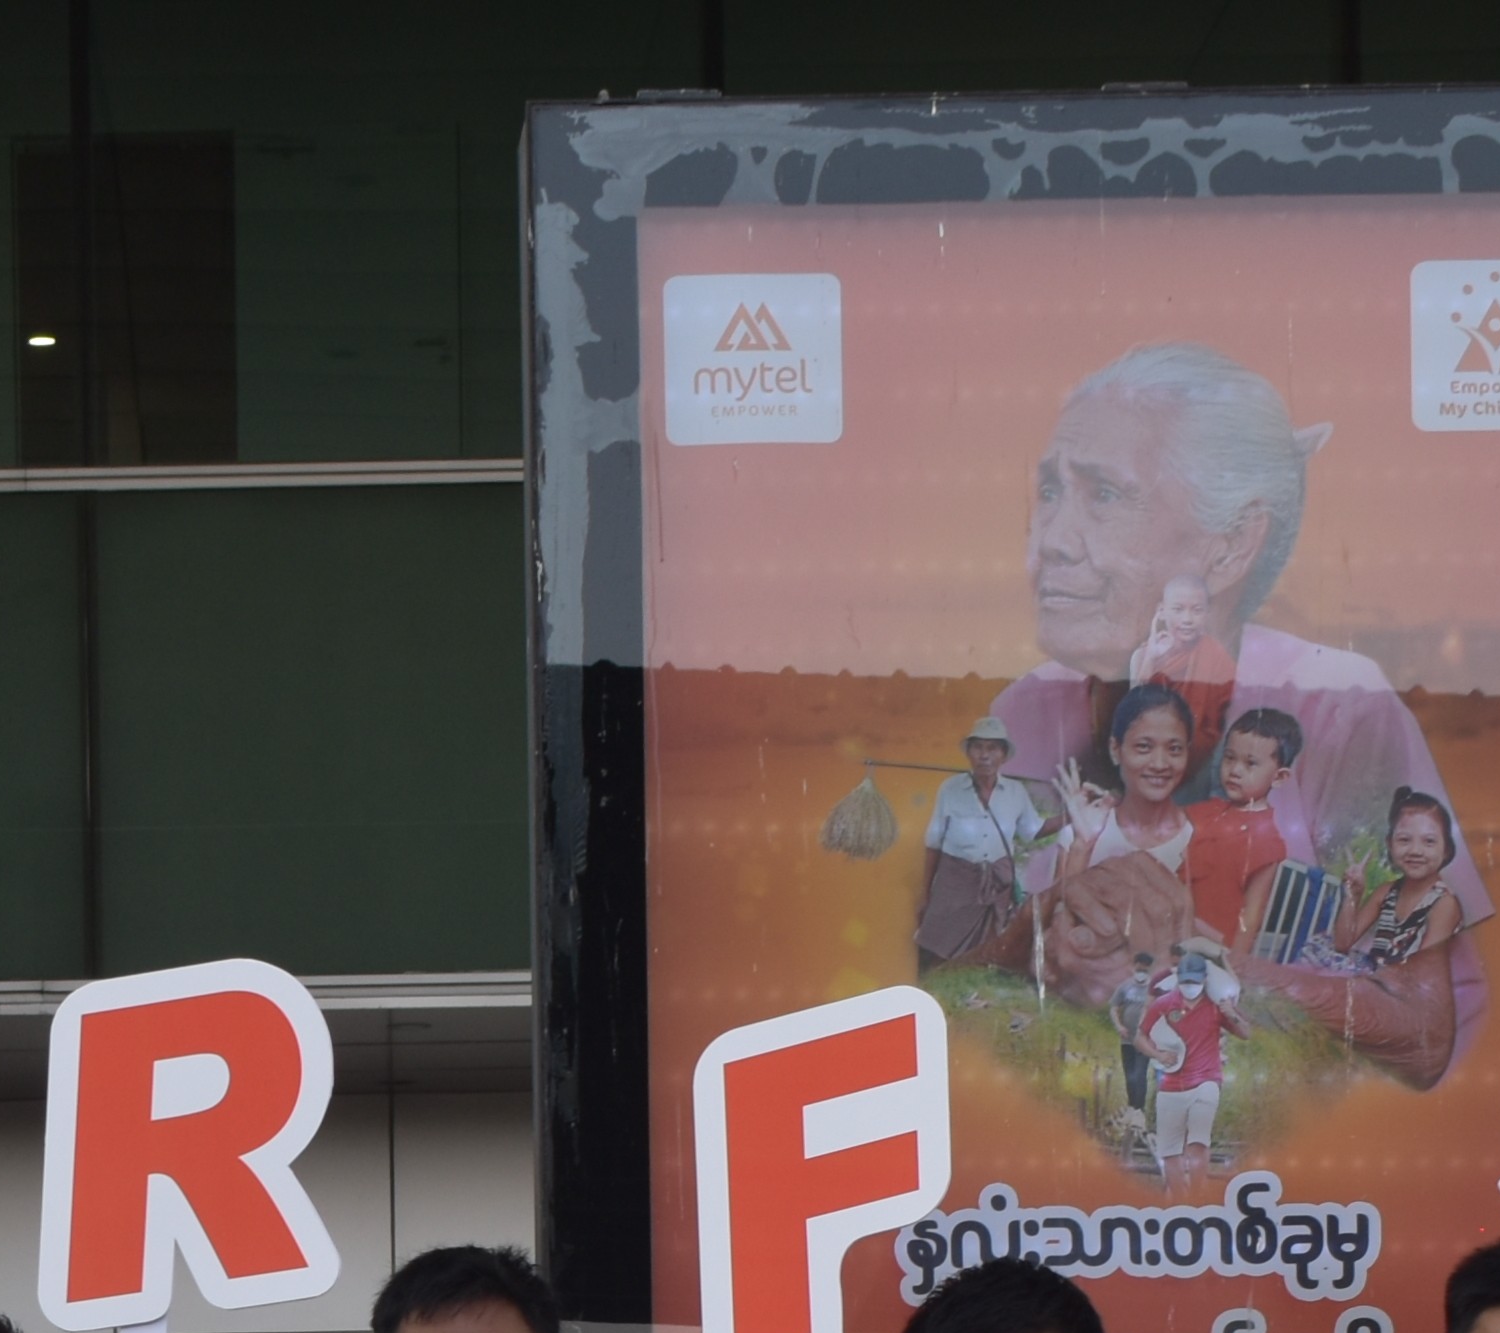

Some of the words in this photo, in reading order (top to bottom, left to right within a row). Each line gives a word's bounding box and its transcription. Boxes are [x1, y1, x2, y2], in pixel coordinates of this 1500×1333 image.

[693, 358, 813, 402] mytel
[711, 404, 798, 418] EMPOWER
[1439, 402, 1467, 419] My
[65, 989, 310, 1304] R
